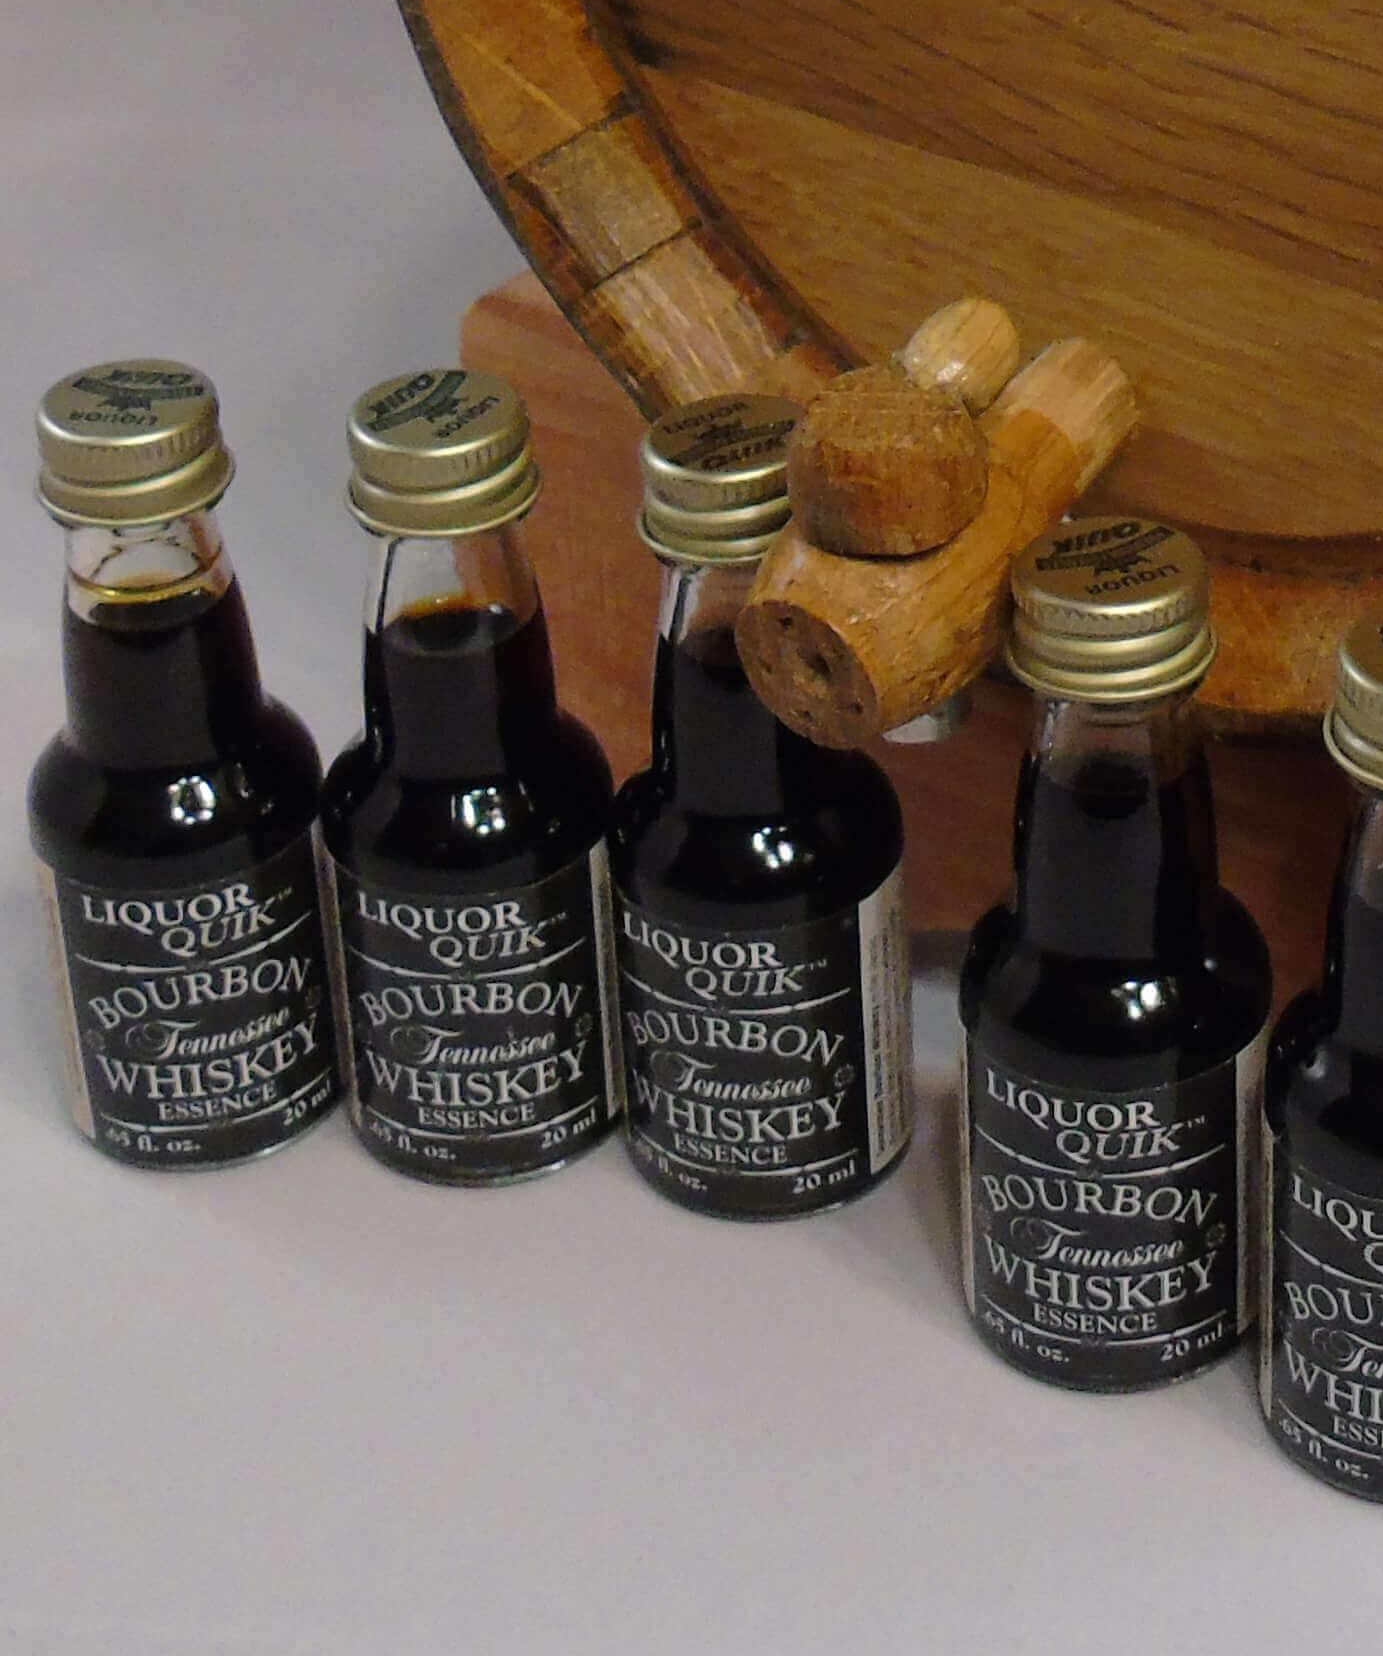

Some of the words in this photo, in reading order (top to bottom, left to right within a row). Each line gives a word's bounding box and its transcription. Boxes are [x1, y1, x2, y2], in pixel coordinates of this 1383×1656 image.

[83, 883, 255, 935] LIQUOR
[161, 897, 276, 957] QUIK
[358, 892, 526, 940] LIQUOR
[429, 921, 546, 968] QUIK
[623, 912, 781, 969] LIQUOR
[88, 957, 310, 1029] BOURBON
[360, 981, 582, 1026] BOURBON
[685, 964, 805, 1001] QUIK
[97, 1012, 317, 1099] WHISKEY
[126, 1007, 289, 1060] Tennessee
[389, 1024, 556, 1065] Tennessee
[626, 1009, 844, 1067] BOURBON
[365, 1040, 587, 1107] WHISKEY
[651, 1050, 811, 1101] Tennessee
[158, 1081, 276, 1121] ESSENCE
[282, 1102, 307, 1126] 20
[310, 1080, 332, 1108] ml
[418, 1102, 535, 1129] ESSENCE
[632, 1068, 845, 1145] WHISKEY
[985, 1067, 1161, 1130] LIQUOR
[541, 1127, 567, 1149] 20
[571, 1109, 597, 1136] ml
[673, 1132, 788, 1165] ESSENCE
[1055, 1123, 1183, 1164] QUIK
[792, 1172, 820, 1194] 20
[826, 1159, 856, 1185] ml
[981, 1174, 1218, 1226] BOURBON
[1010, 1216, 1184, 1268] Tennessee
[983, 1233, 1218, 1312] WHISKEY
[1033, 1302, 1157, 1335] ESSENCE
[1160, 1340, 1190, 1362] 20
[1197, 1322, 1224, 1350] ml
